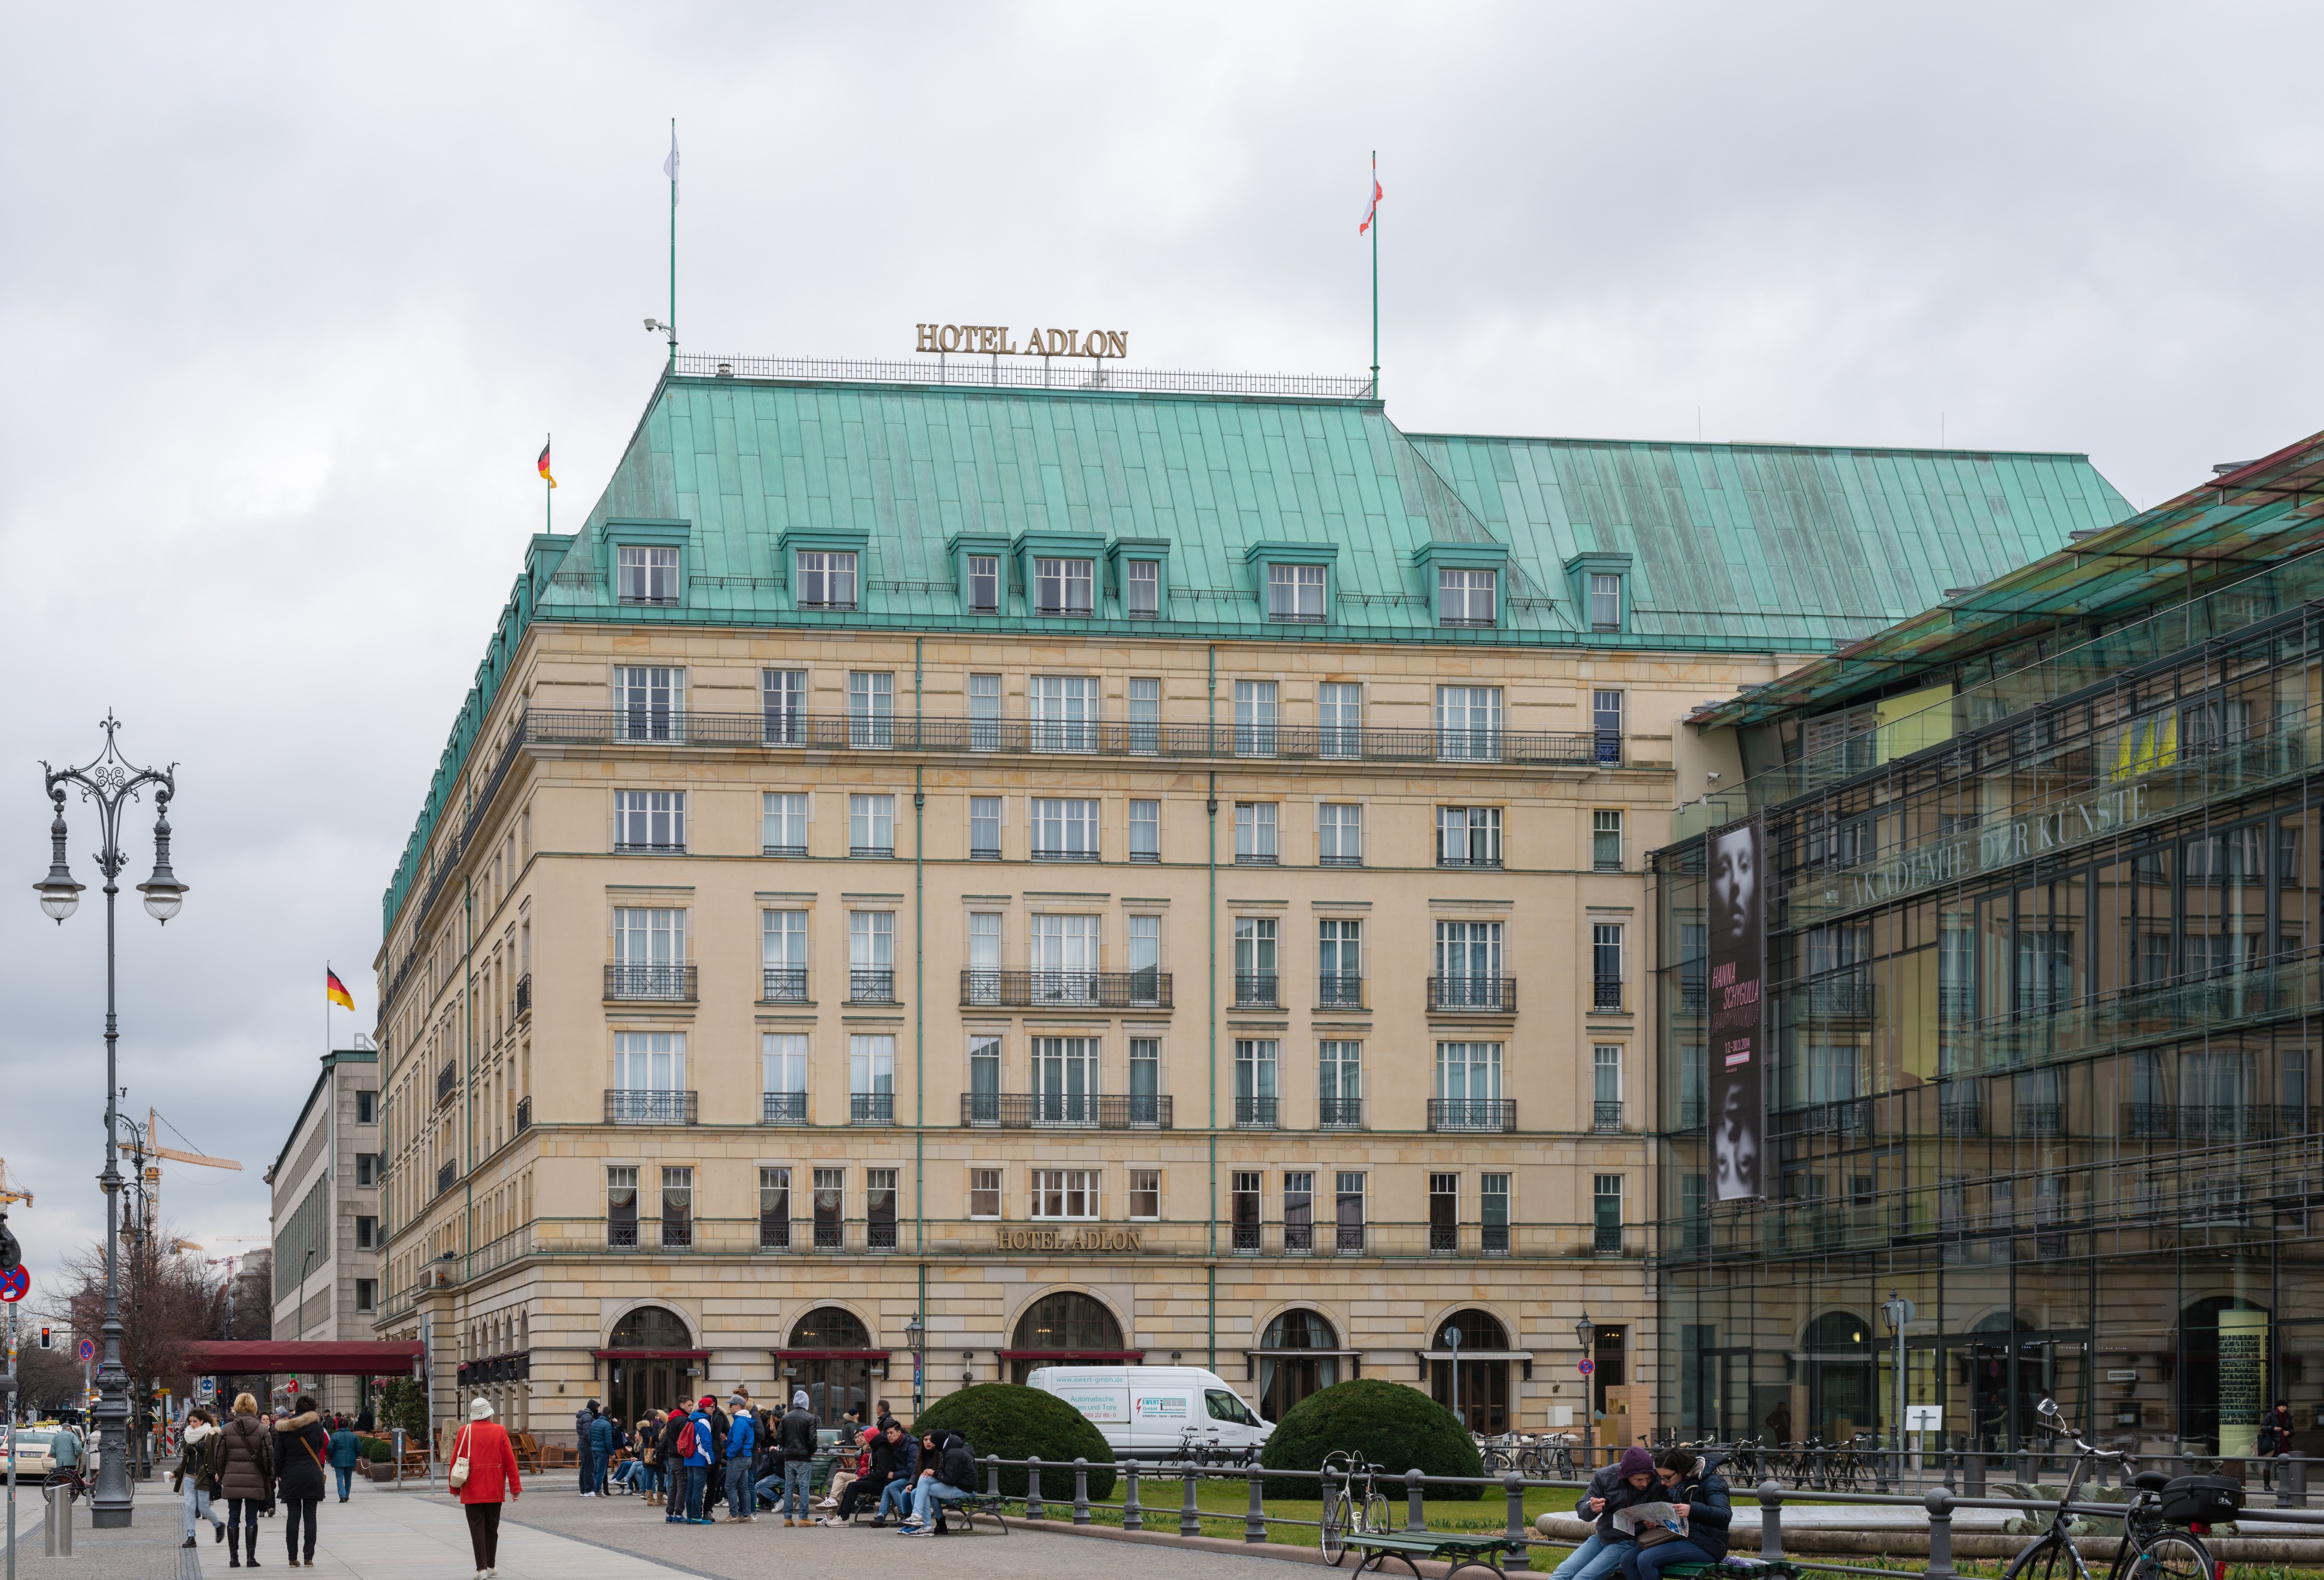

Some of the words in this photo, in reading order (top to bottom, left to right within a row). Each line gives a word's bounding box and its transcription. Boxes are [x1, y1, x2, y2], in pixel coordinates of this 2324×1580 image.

[916, 324, 1016, 354] HOTEL
[1024, 328, 1128, 358] ADLON
[1850, 841, 1970, 907] AKADEMIE
[1979, 822, 2029, 869] DER
[2038, 783, 2149, 850] KÜNSTE
[1712, 961, 1736, 990] HANNA
[1723, 978, 1759, 1010] SCHYGULLA
[1712, 1002, 1760, 1036] TRAUMPROTOKOLLE
[998, 1231, 1066, 1250] HOTEL
[1071, 1232, 1141, 1251] ADLON
[916, 1370, 920, 1383] P
